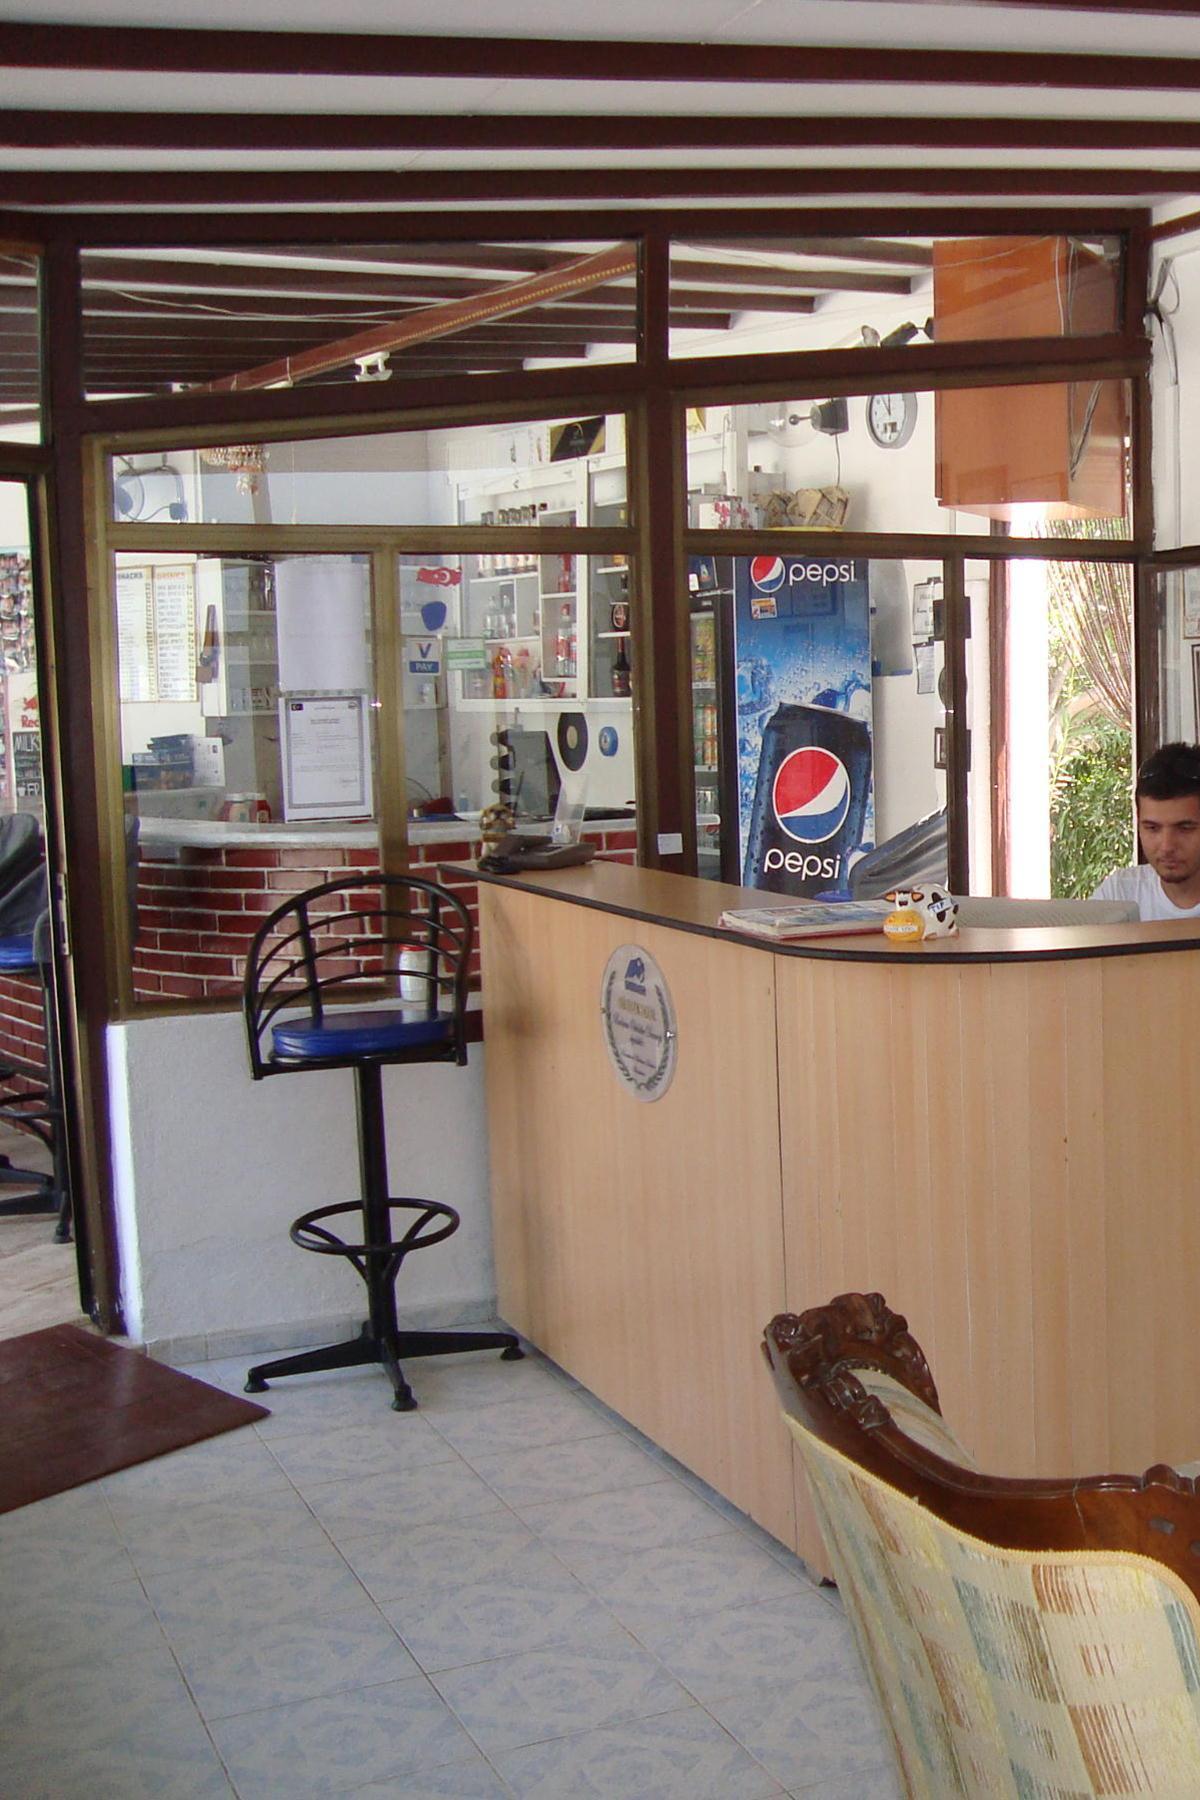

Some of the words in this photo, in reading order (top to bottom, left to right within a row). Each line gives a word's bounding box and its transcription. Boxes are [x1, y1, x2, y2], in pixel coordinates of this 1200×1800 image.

[788, 560, 856, 587] pepsi
[414, 661, 434, 672] PAY
[763, 848, 841, 881] pepsi
